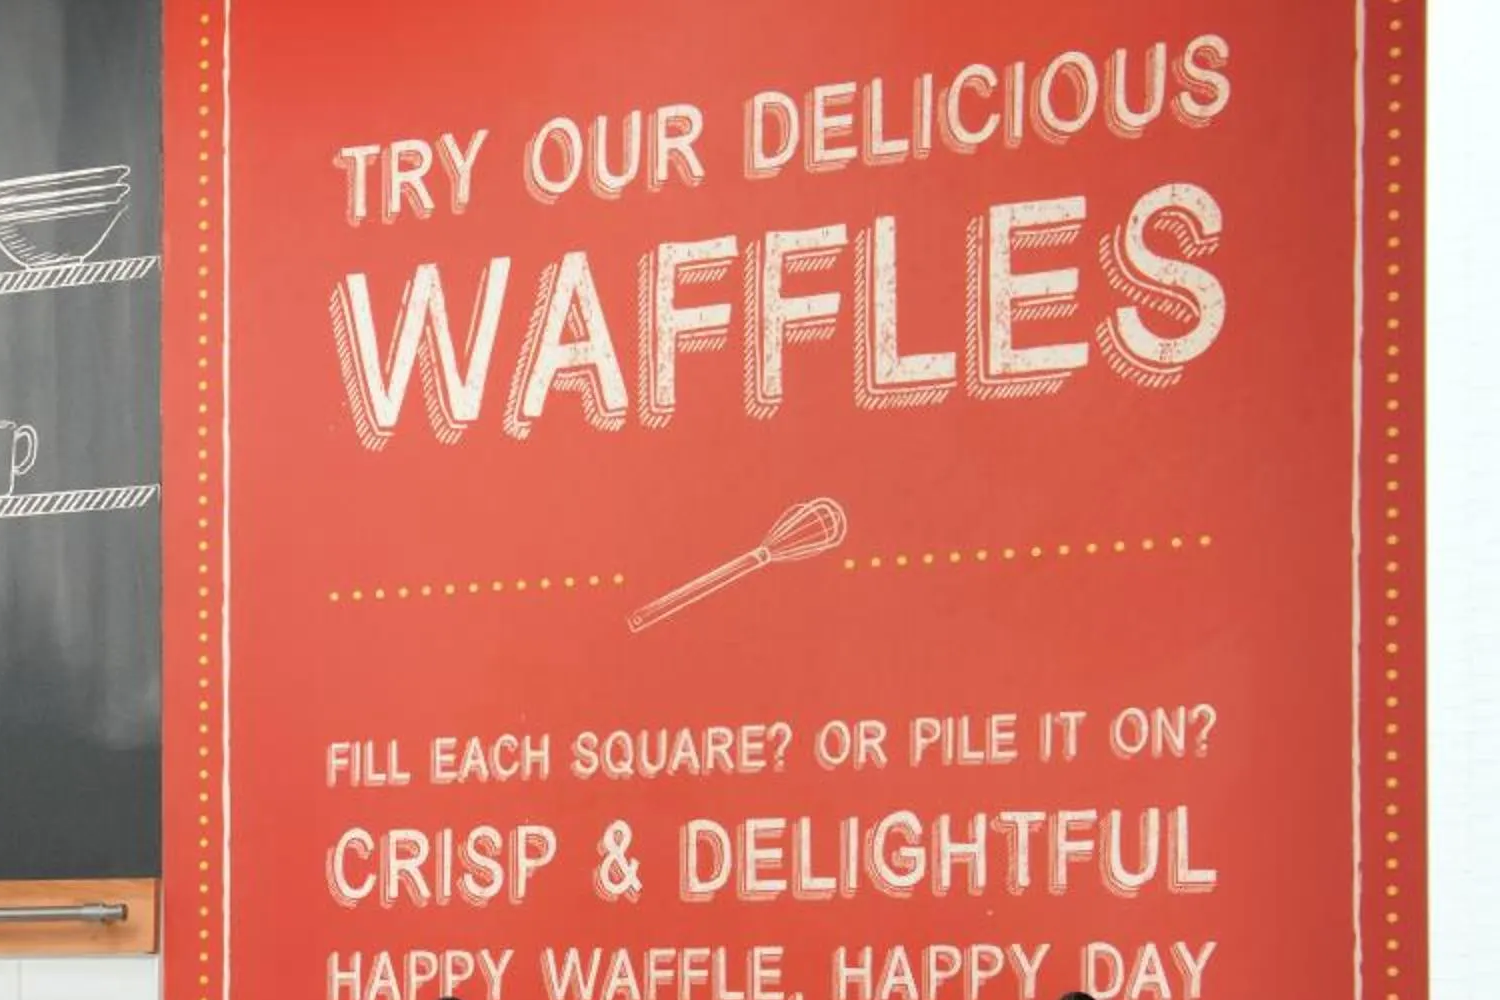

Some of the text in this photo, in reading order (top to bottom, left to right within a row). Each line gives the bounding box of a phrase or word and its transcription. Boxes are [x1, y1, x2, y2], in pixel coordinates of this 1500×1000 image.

[333, 34, 1231, 226] TRY OUR DELICIOUS
[329, 183, 1226, 451] WAFFLES
[327, 703, 1217, 787] FILL EACH SQUARE? OR PILE IT ON?
[326, 805, 1218, 909] CRISP & DELIGHTFUL
